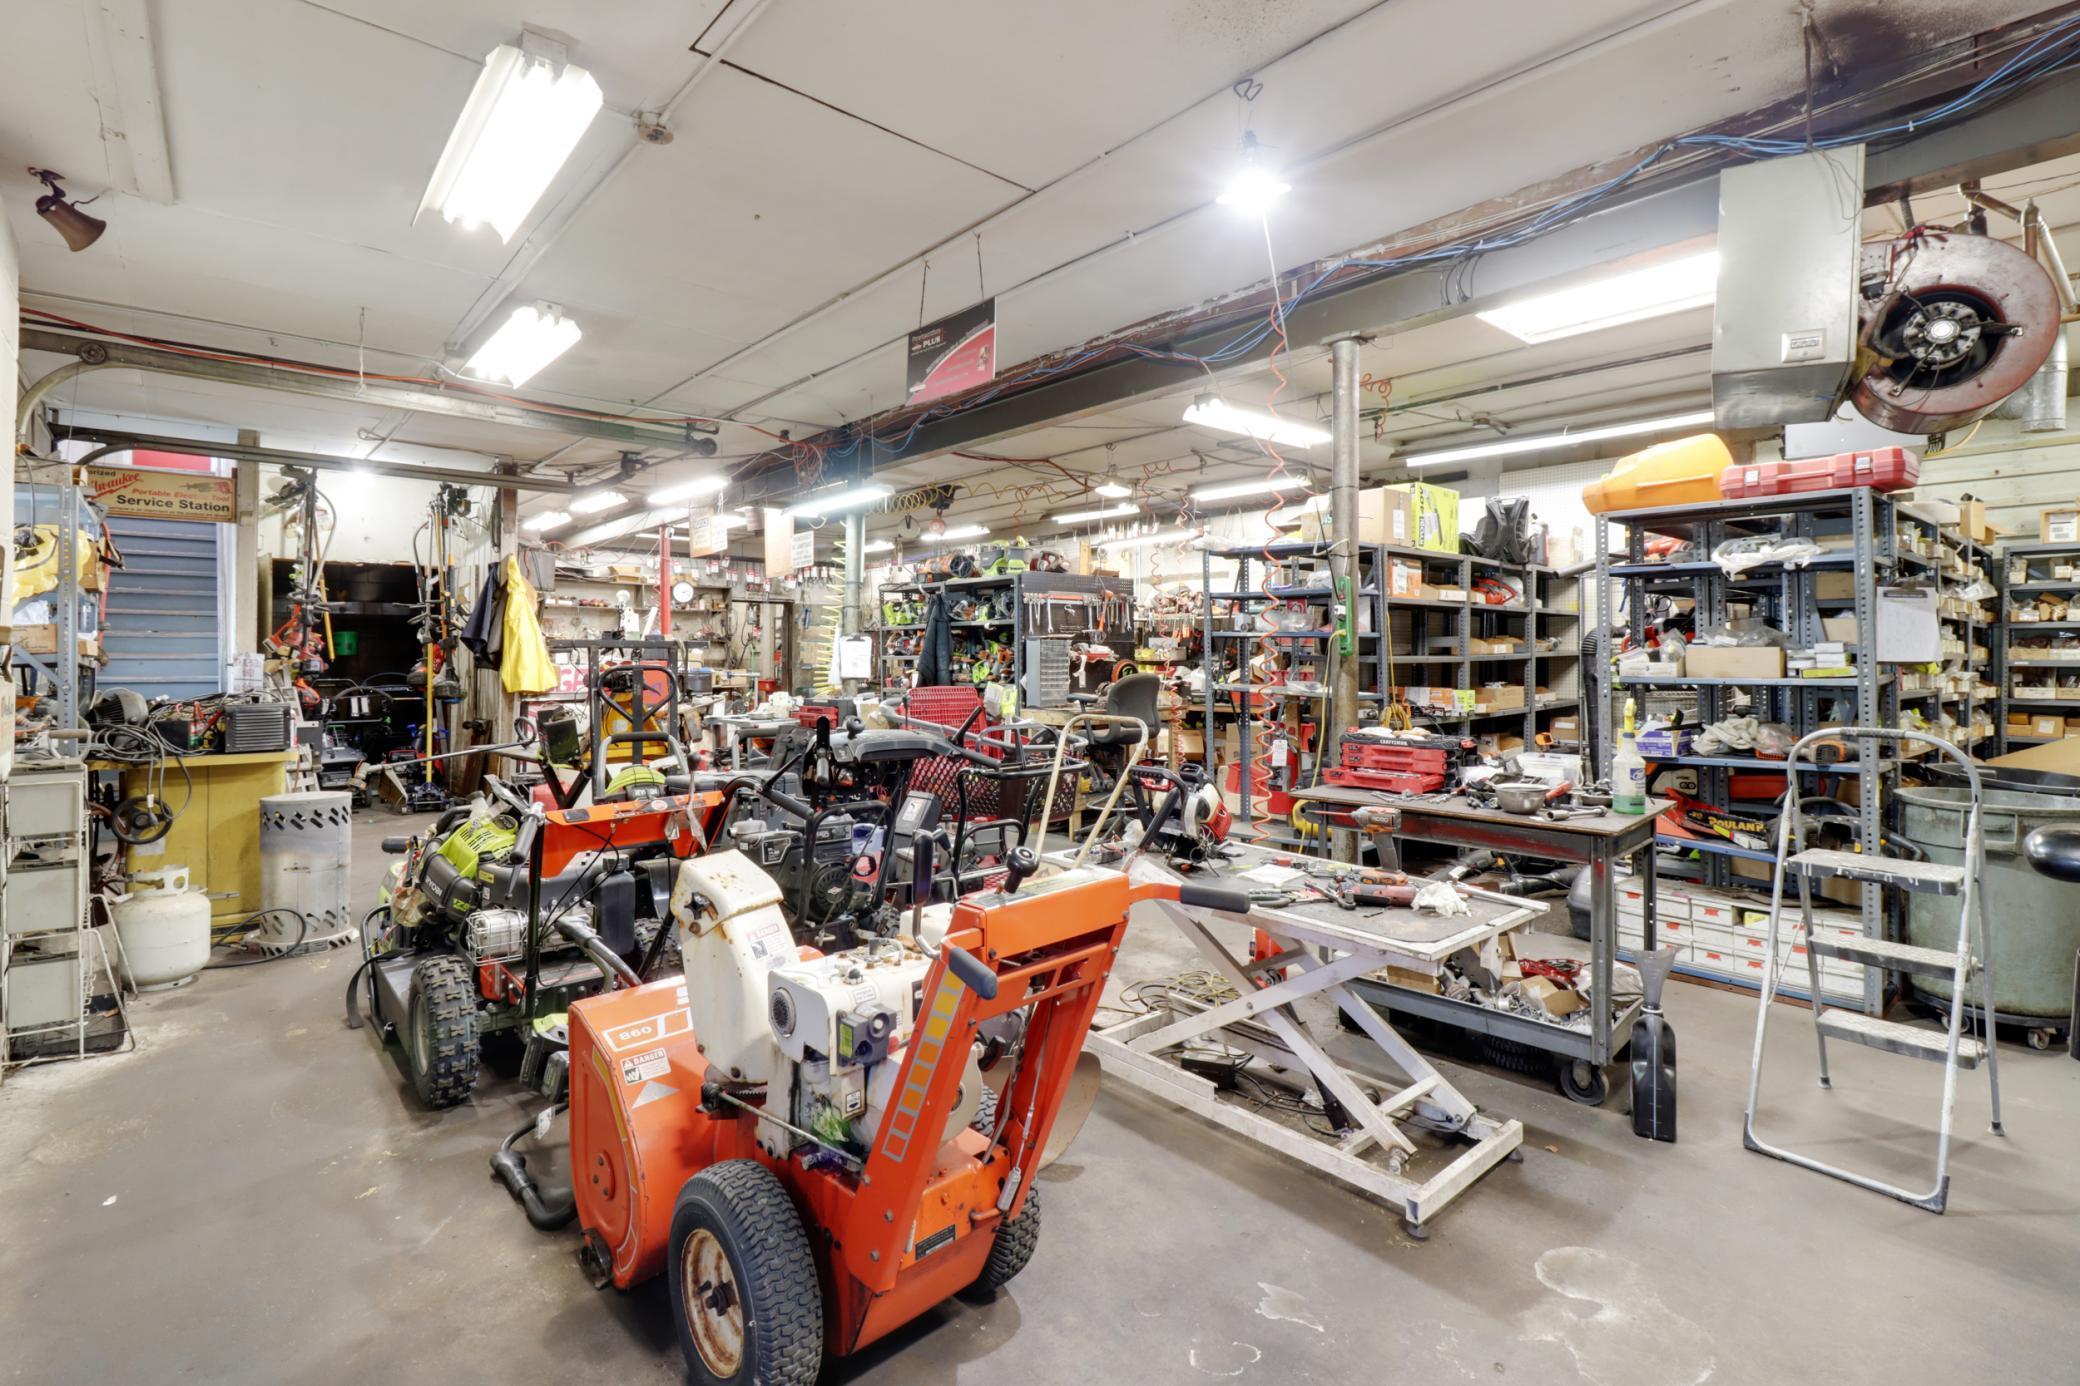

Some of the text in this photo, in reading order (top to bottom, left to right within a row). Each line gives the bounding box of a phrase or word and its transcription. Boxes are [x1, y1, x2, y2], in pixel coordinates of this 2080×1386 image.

[88, 469, 117, 478] orized
[132, 487, 171, 497] Portable
[116, 494, 174, 509] Service
[178, 499, 230, 513] Station
[425, 876, 443, 896] RYOBI
[633, 1049, 665, 1067] DANGER
